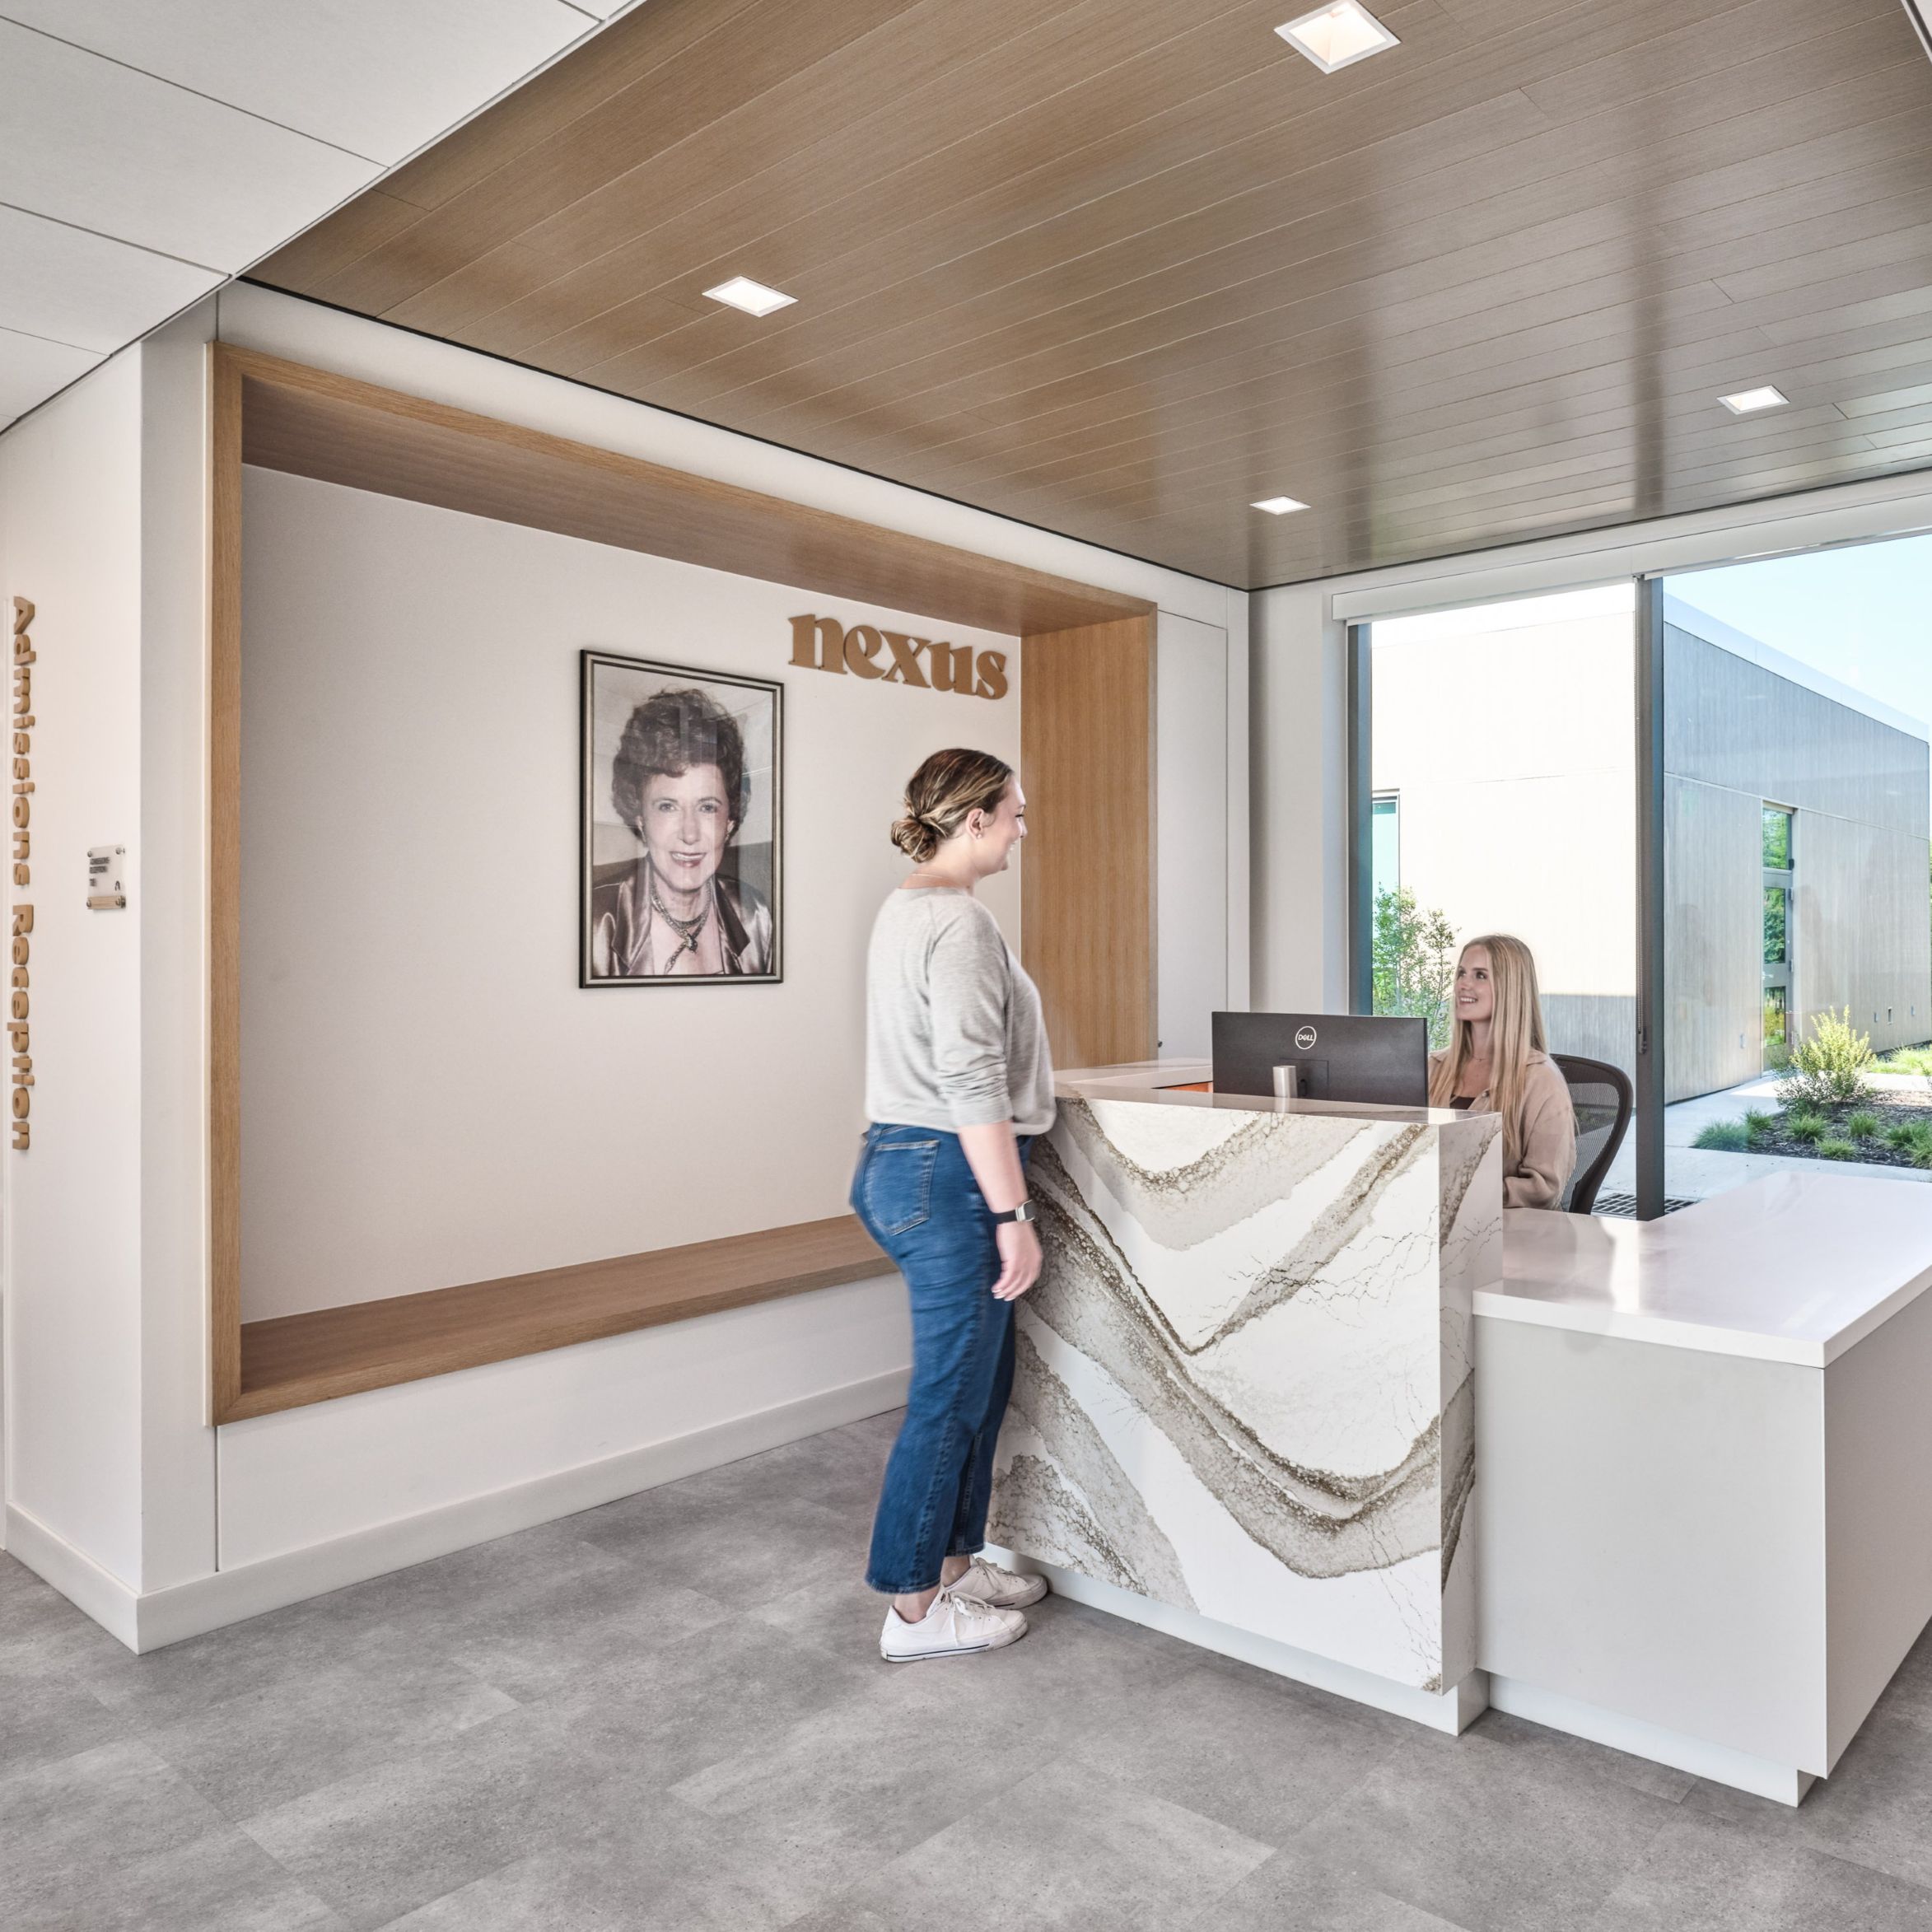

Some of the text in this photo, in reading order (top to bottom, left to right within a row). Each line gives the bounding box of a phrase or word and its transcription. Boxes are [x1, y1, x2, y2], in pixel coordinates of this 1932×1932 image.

[787, 614, 1008, 700] nexus
[7, 596, 36, 1150] Admissions Reception
